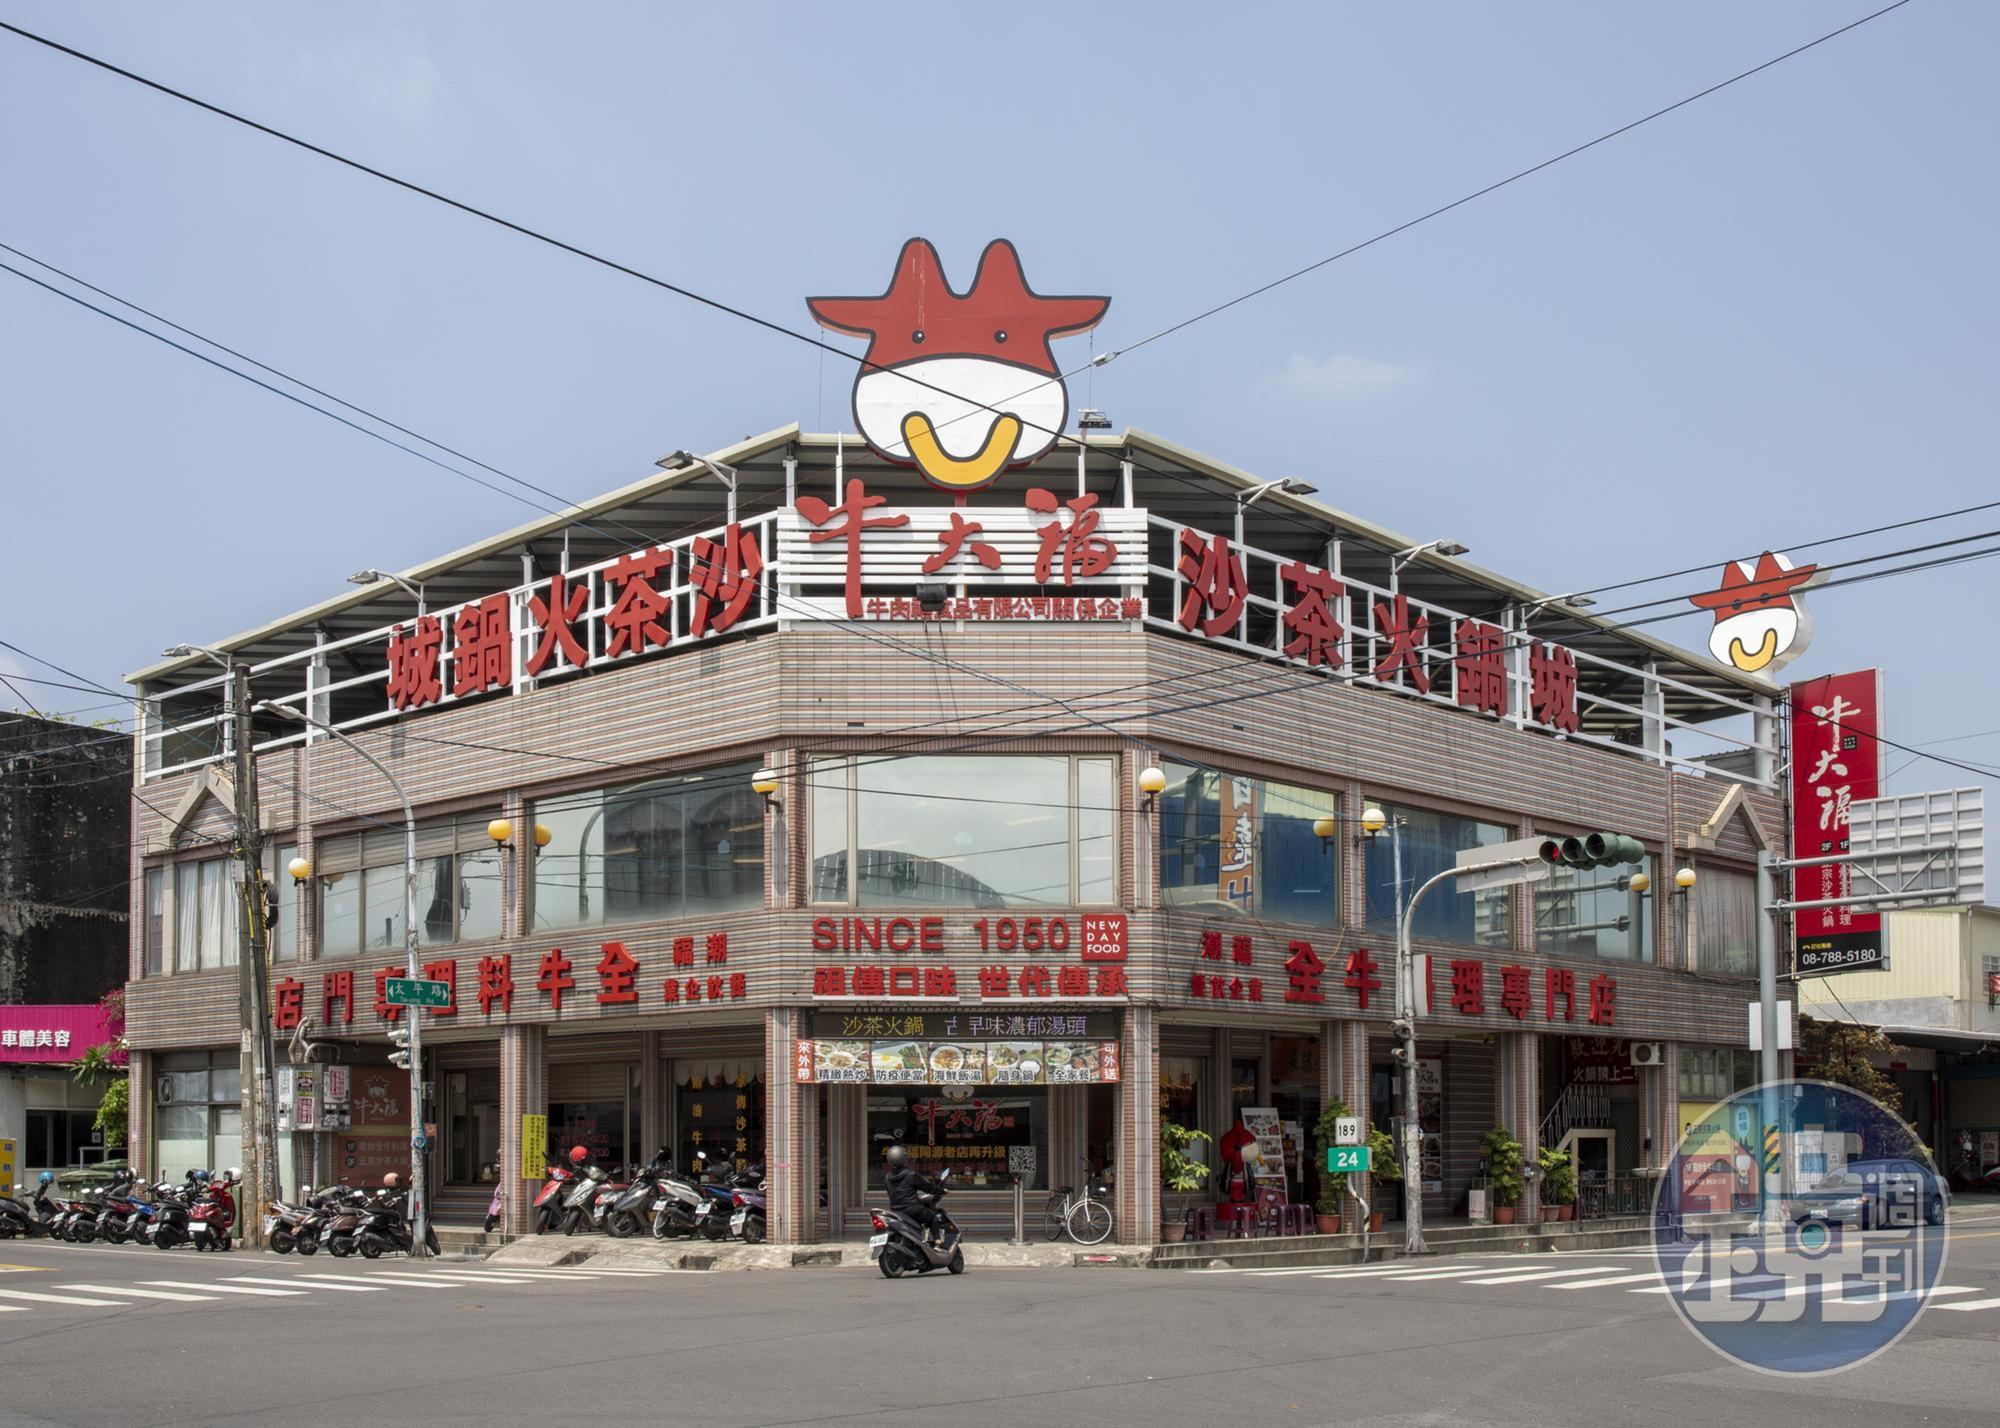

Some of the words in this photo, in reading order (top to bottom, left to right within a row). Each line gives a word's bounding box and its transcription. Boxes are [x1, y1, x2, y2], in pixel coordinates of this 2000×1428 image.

[795, 479, 1117, 618] 牛大福
[1179, 528, 1579, 733] 沙茶火鍋城
[1808, 695, 1861, 831] 牛大福
[1821, 842, 1831, 851] 2F
[1840, 840, 1849, 849] 1F
[812, 916, 945, 951] SINCE
[973, 916, 1070, 951] 1950
[1086, 921, 1120, 930] NEW
[1086, 932, 1120, 942] DAY
[1086, 944, 1120, 954] FOOD
[1803, 949, 1875, 964] 08-788-5180
[395, 982, 442, 997] 太平路
[812, 965, 957, 997] 祖傳口味
[977, 965, 1128, 998] 世代傳承
[1284, 939, 1617, 1026] 全牛理專門店
[842, 1015, 924, 1036] 沙茶火鍋
[1, 1029, 70, 1047] 車體美容
[1103, 1042, 1118, 1081] 可外送
[875, 1068, 924, 1082] 防疫便當
[934, 1068, 983, 1082] 海鮮飯湯
[353, 1097, 399, 1125] 牛大福
[912, 1099, 1003, 1146] 牛大福
[1339, 1125, 1355, 1136] 189
[1337, 1151, 1359, 1167] 24
